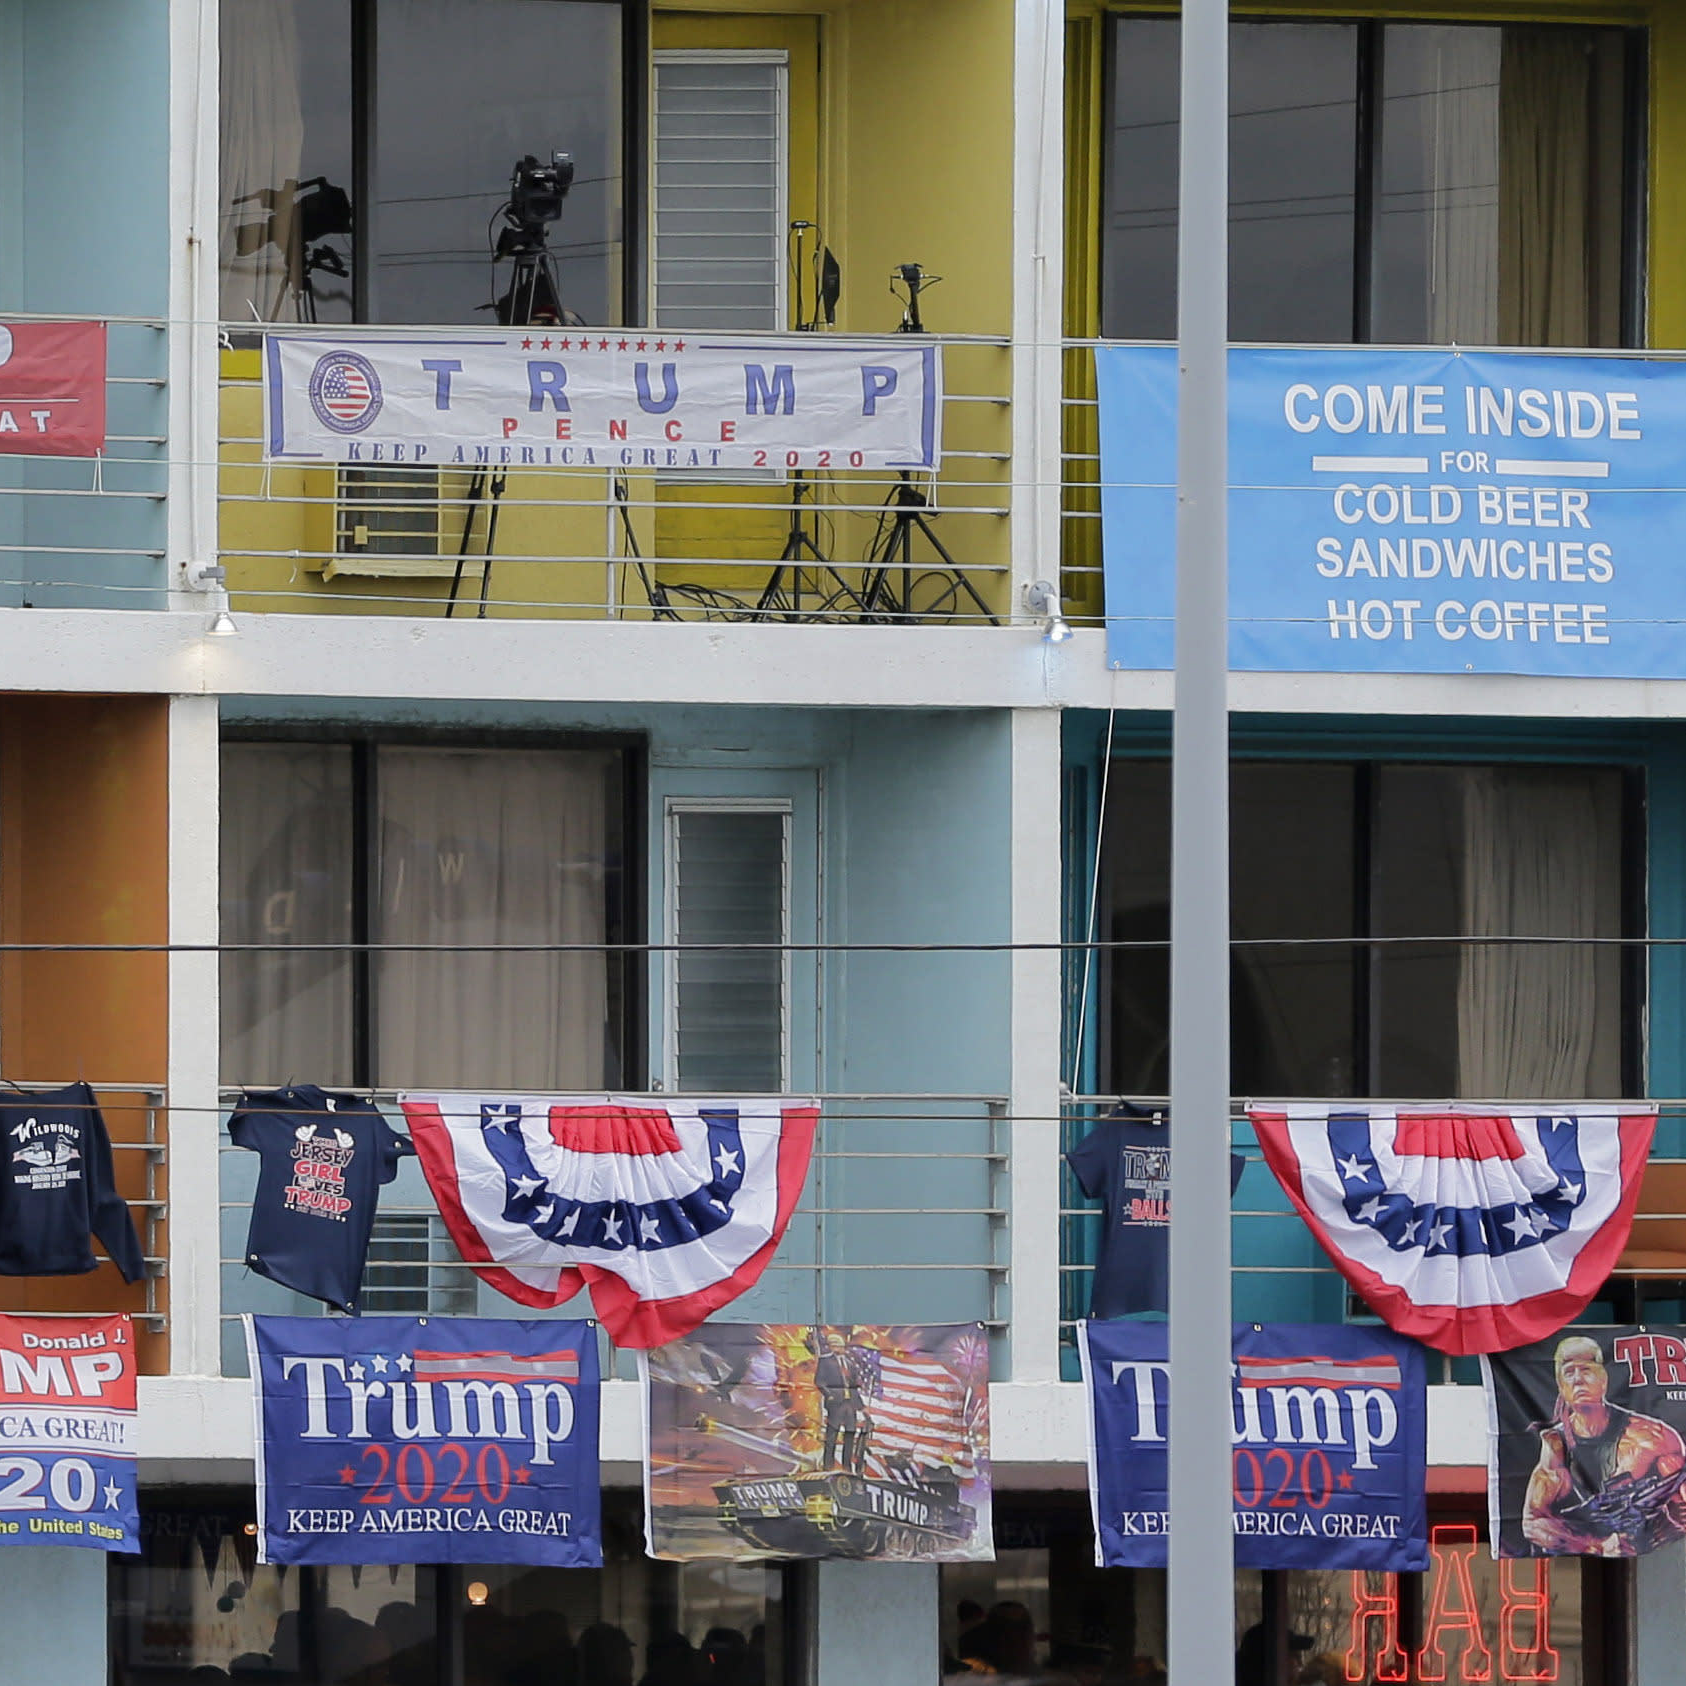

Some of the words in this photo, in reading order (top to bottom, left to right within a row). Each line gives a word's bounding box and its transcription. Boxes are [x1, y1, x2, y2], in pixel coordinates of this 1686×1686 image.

[421, 359, 898, 417] TRUMP
[1284, 384, 1446, 435] COME
[1466, 386, 1642, 440] INSIDE
[503, 417, 737, 443] PENCE
[348, 442, 428, 463] KEEP
[453, 444, 610, 466] AMERICA
[619, 446, 723, 467] GREAT
[753, 449, 864, 468] 2020
[1441, 452, 1489, 474] FOR
[1333, 484, 1463, 526] COLD
[1478, 485, 1591, 529] BEER
[1316, 537, 1614, 584] SANDWICHES
[1328, 600, 1422, 641] HOT
[1435, 600, 1610, 645] COFFEE
[290, 1141, 355, 1168] JERSEY
[294, 1160, 345, 1182] GIRL
[284, 1186, 352, 1214] TRUMP
[22, 1330, 107, 1351] Donald
[112, 1332, 127, 1346] J.
[283, 1356, 574, 1466] Trump
[1113, 1357, 1398, 1470] Tump
[45, 1418, 125, 1444] GREAT!
[360, 1442, 510, 1506] 2020
[1232, 1448, 1332, 1508] 020
[733, 1481, 798, 1501] TRUMP
[866, 1484, 928, 1526] TRUMP
[29, 1519, 82, 1538] United
[87, 1521, 124, 1541] States
[286, 1508, 358, 1533] KEEP
[358, 1508, 493, 1534] AMERICA
[498, 1508, 571, 1537] GREAT
[1322, 1514, 1400, 1539] GREAT
